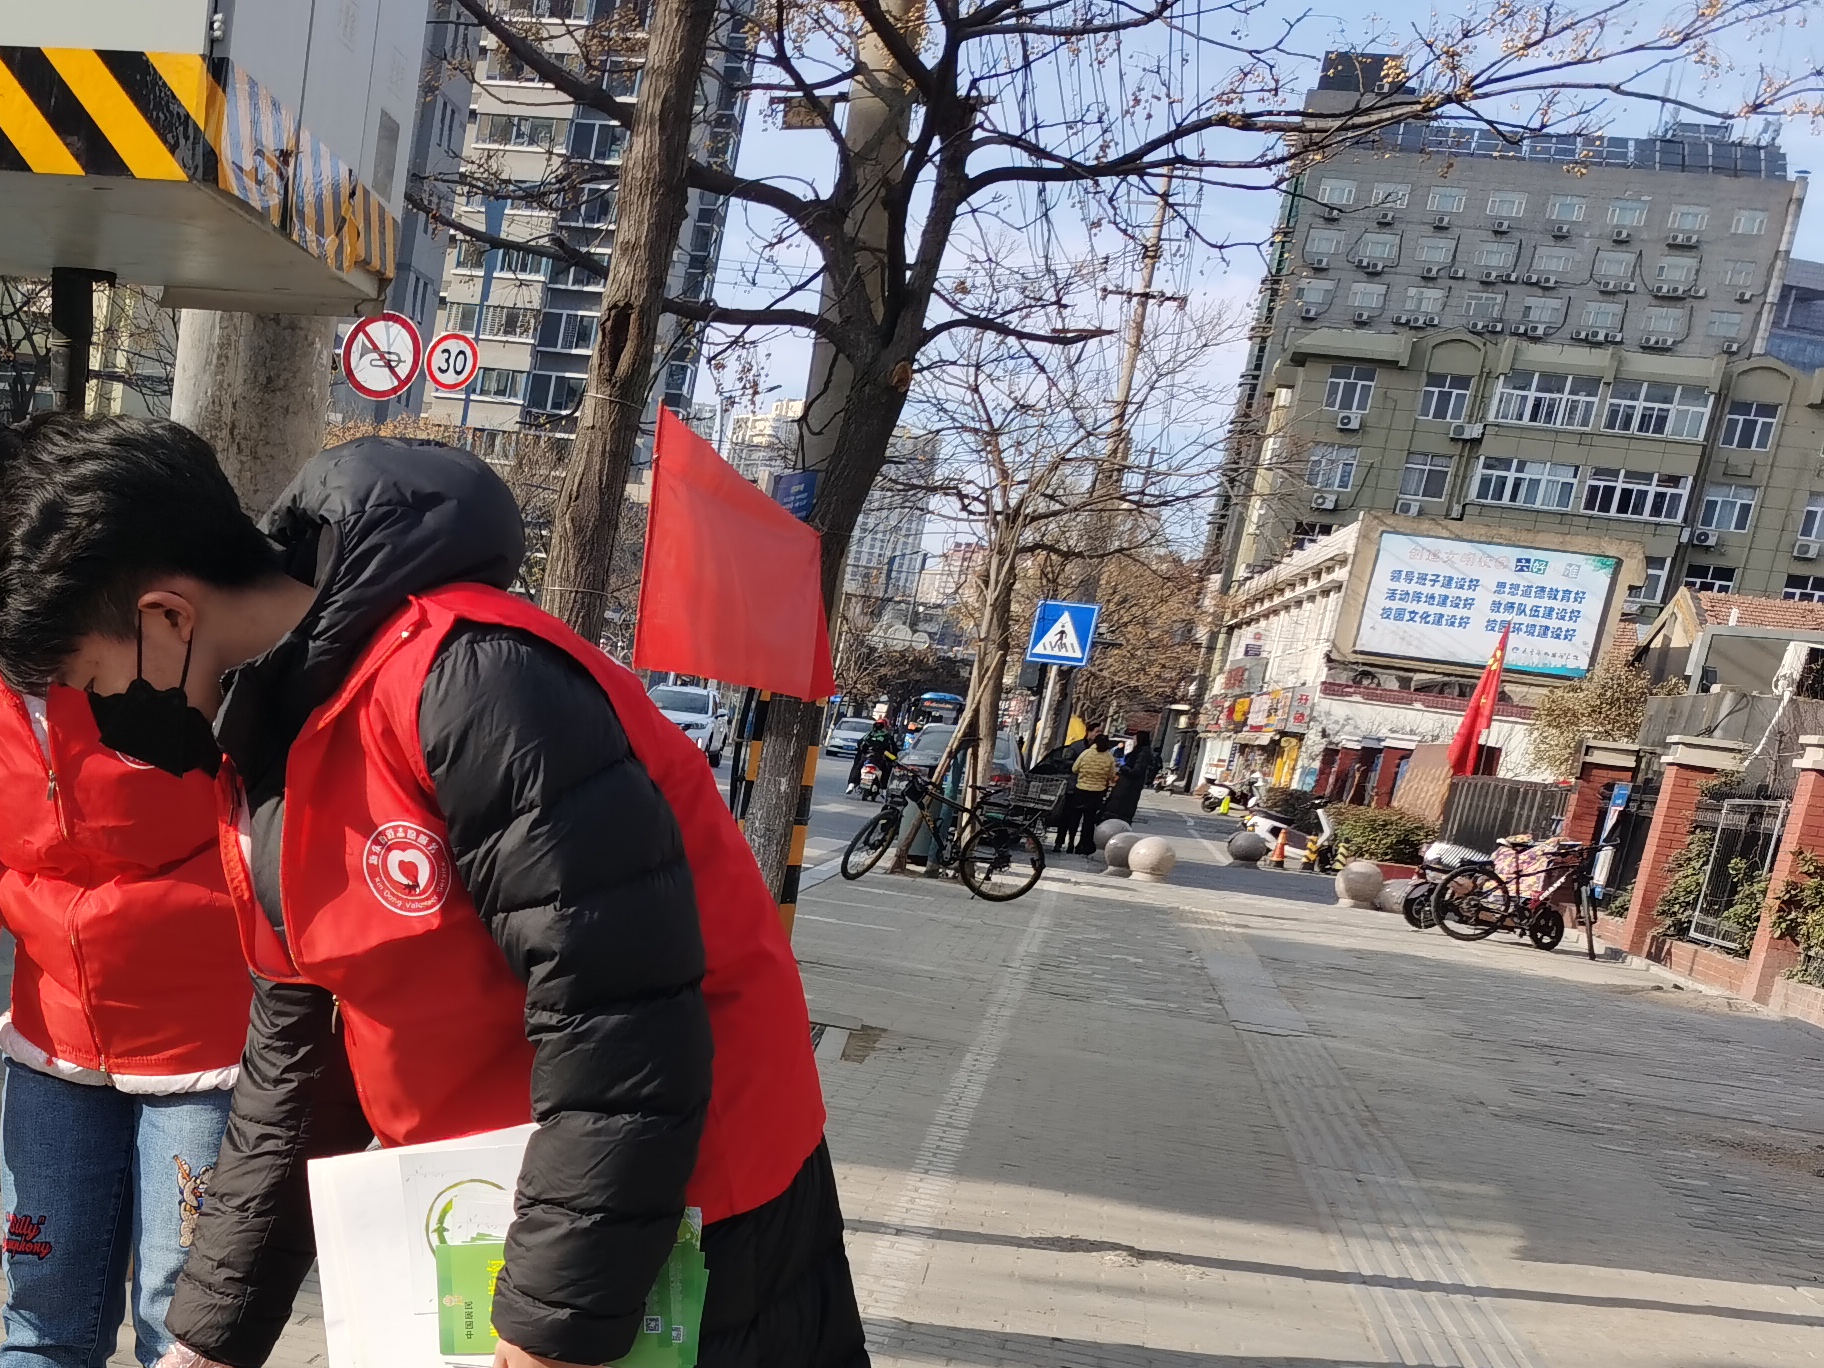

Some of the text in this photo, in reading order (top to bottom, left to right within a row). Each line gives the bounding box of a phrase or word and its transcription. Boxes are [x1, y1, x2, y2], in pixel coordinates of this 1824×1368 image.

[437, 348, 467, 376] 30
[1389, 569, 1481, 592] 领导班子建设好
[1384, 588, 1476, 610] 活动阵地建设好
[1493, 581, 1587, 604] 思想道德教育好
[1380, 606, 1471, 629] 校园文化建设好
[1489, 600, 1582, 623] 教师队伍建设好
